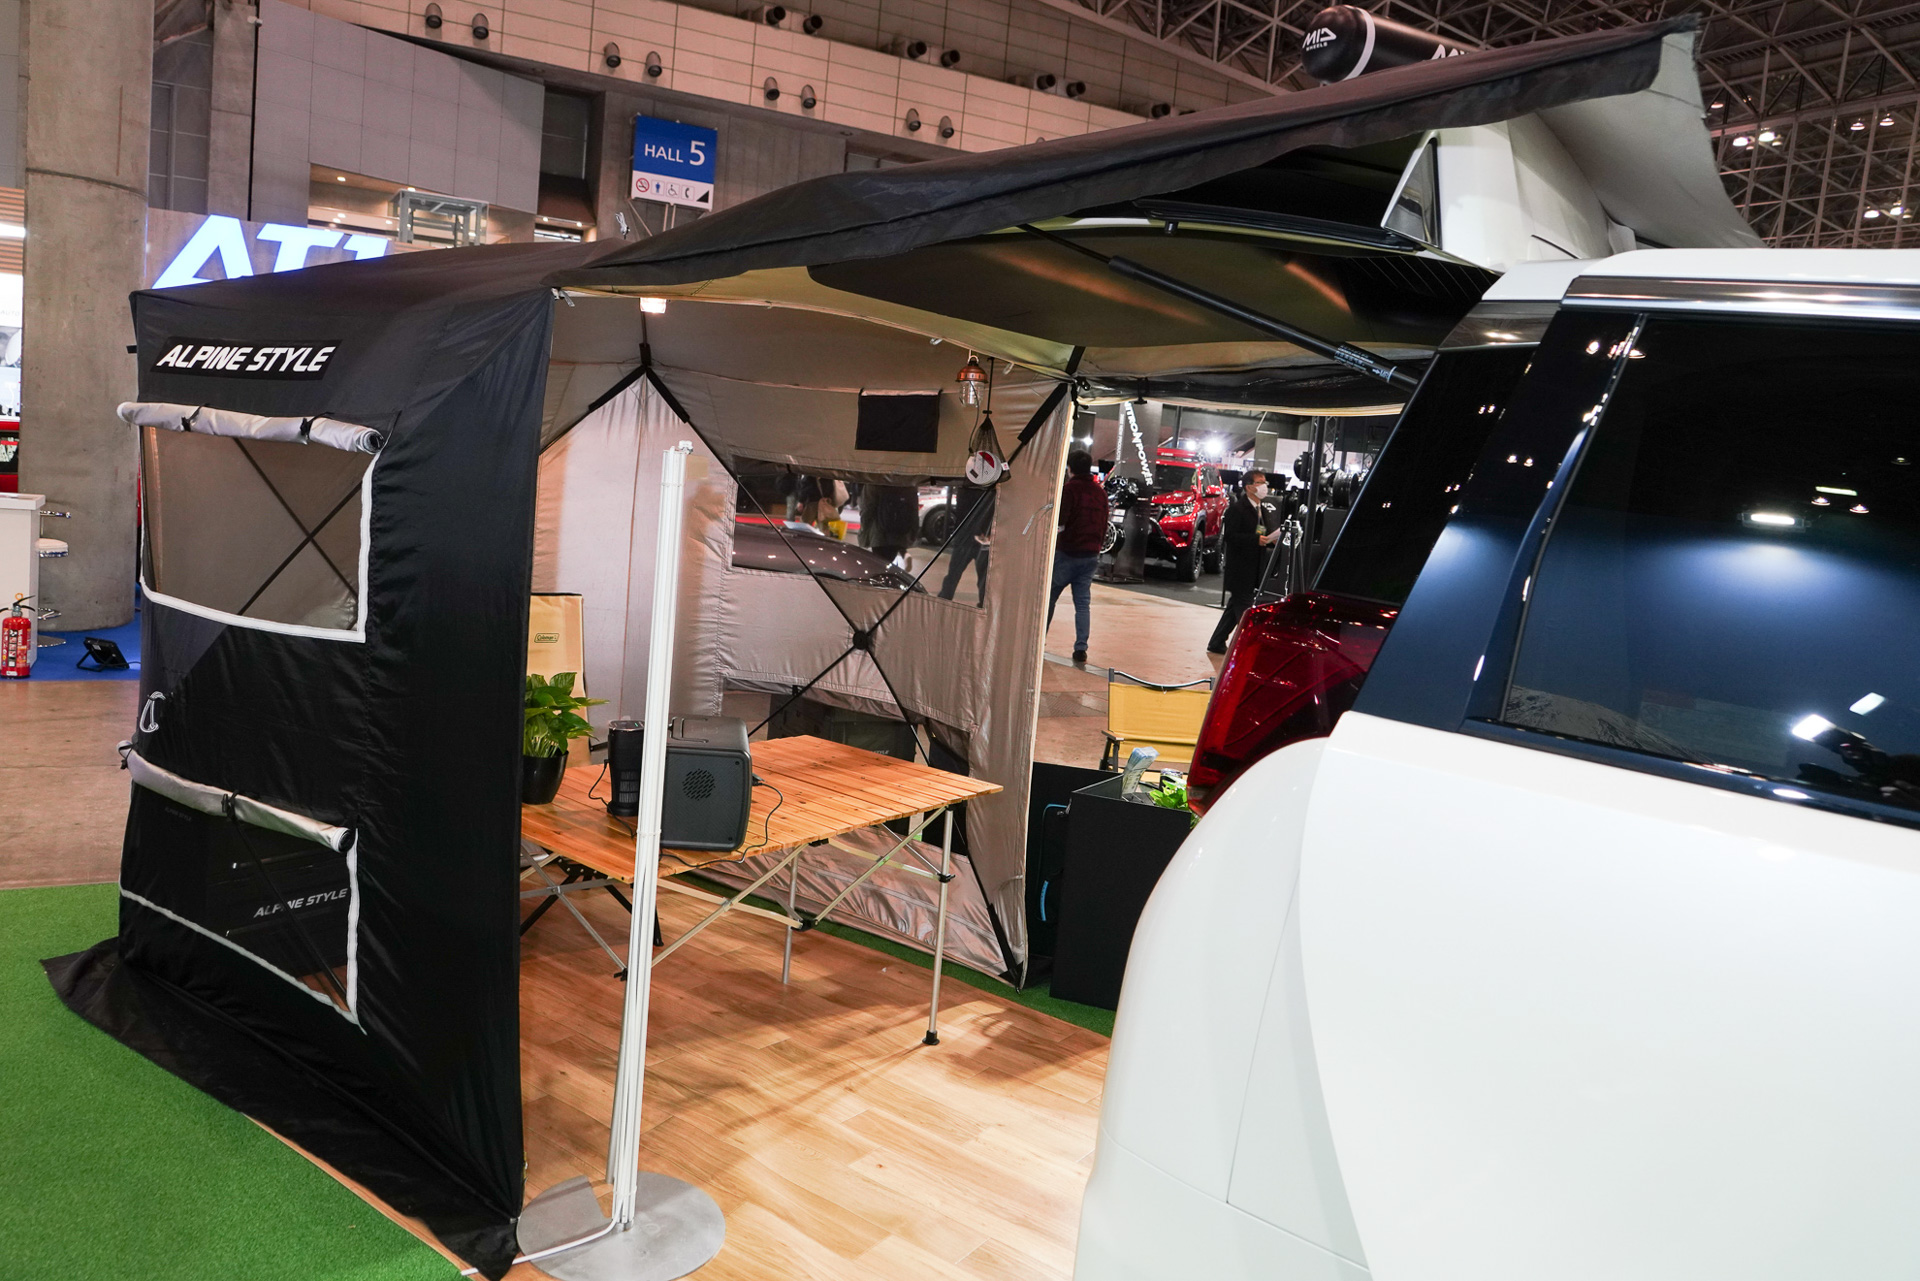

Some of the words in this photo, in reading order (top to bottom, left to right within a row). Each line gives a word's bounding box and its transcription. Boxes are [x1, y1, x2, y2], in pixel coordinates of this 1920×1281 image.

[644, 143, 684, 163] HALL
[689, 140, 706, 166] 5
[156, 344, 253, 371] ALPINE
[245, 346, 336, 373] STYLE
[305, 888, 348, 906] STYLE
